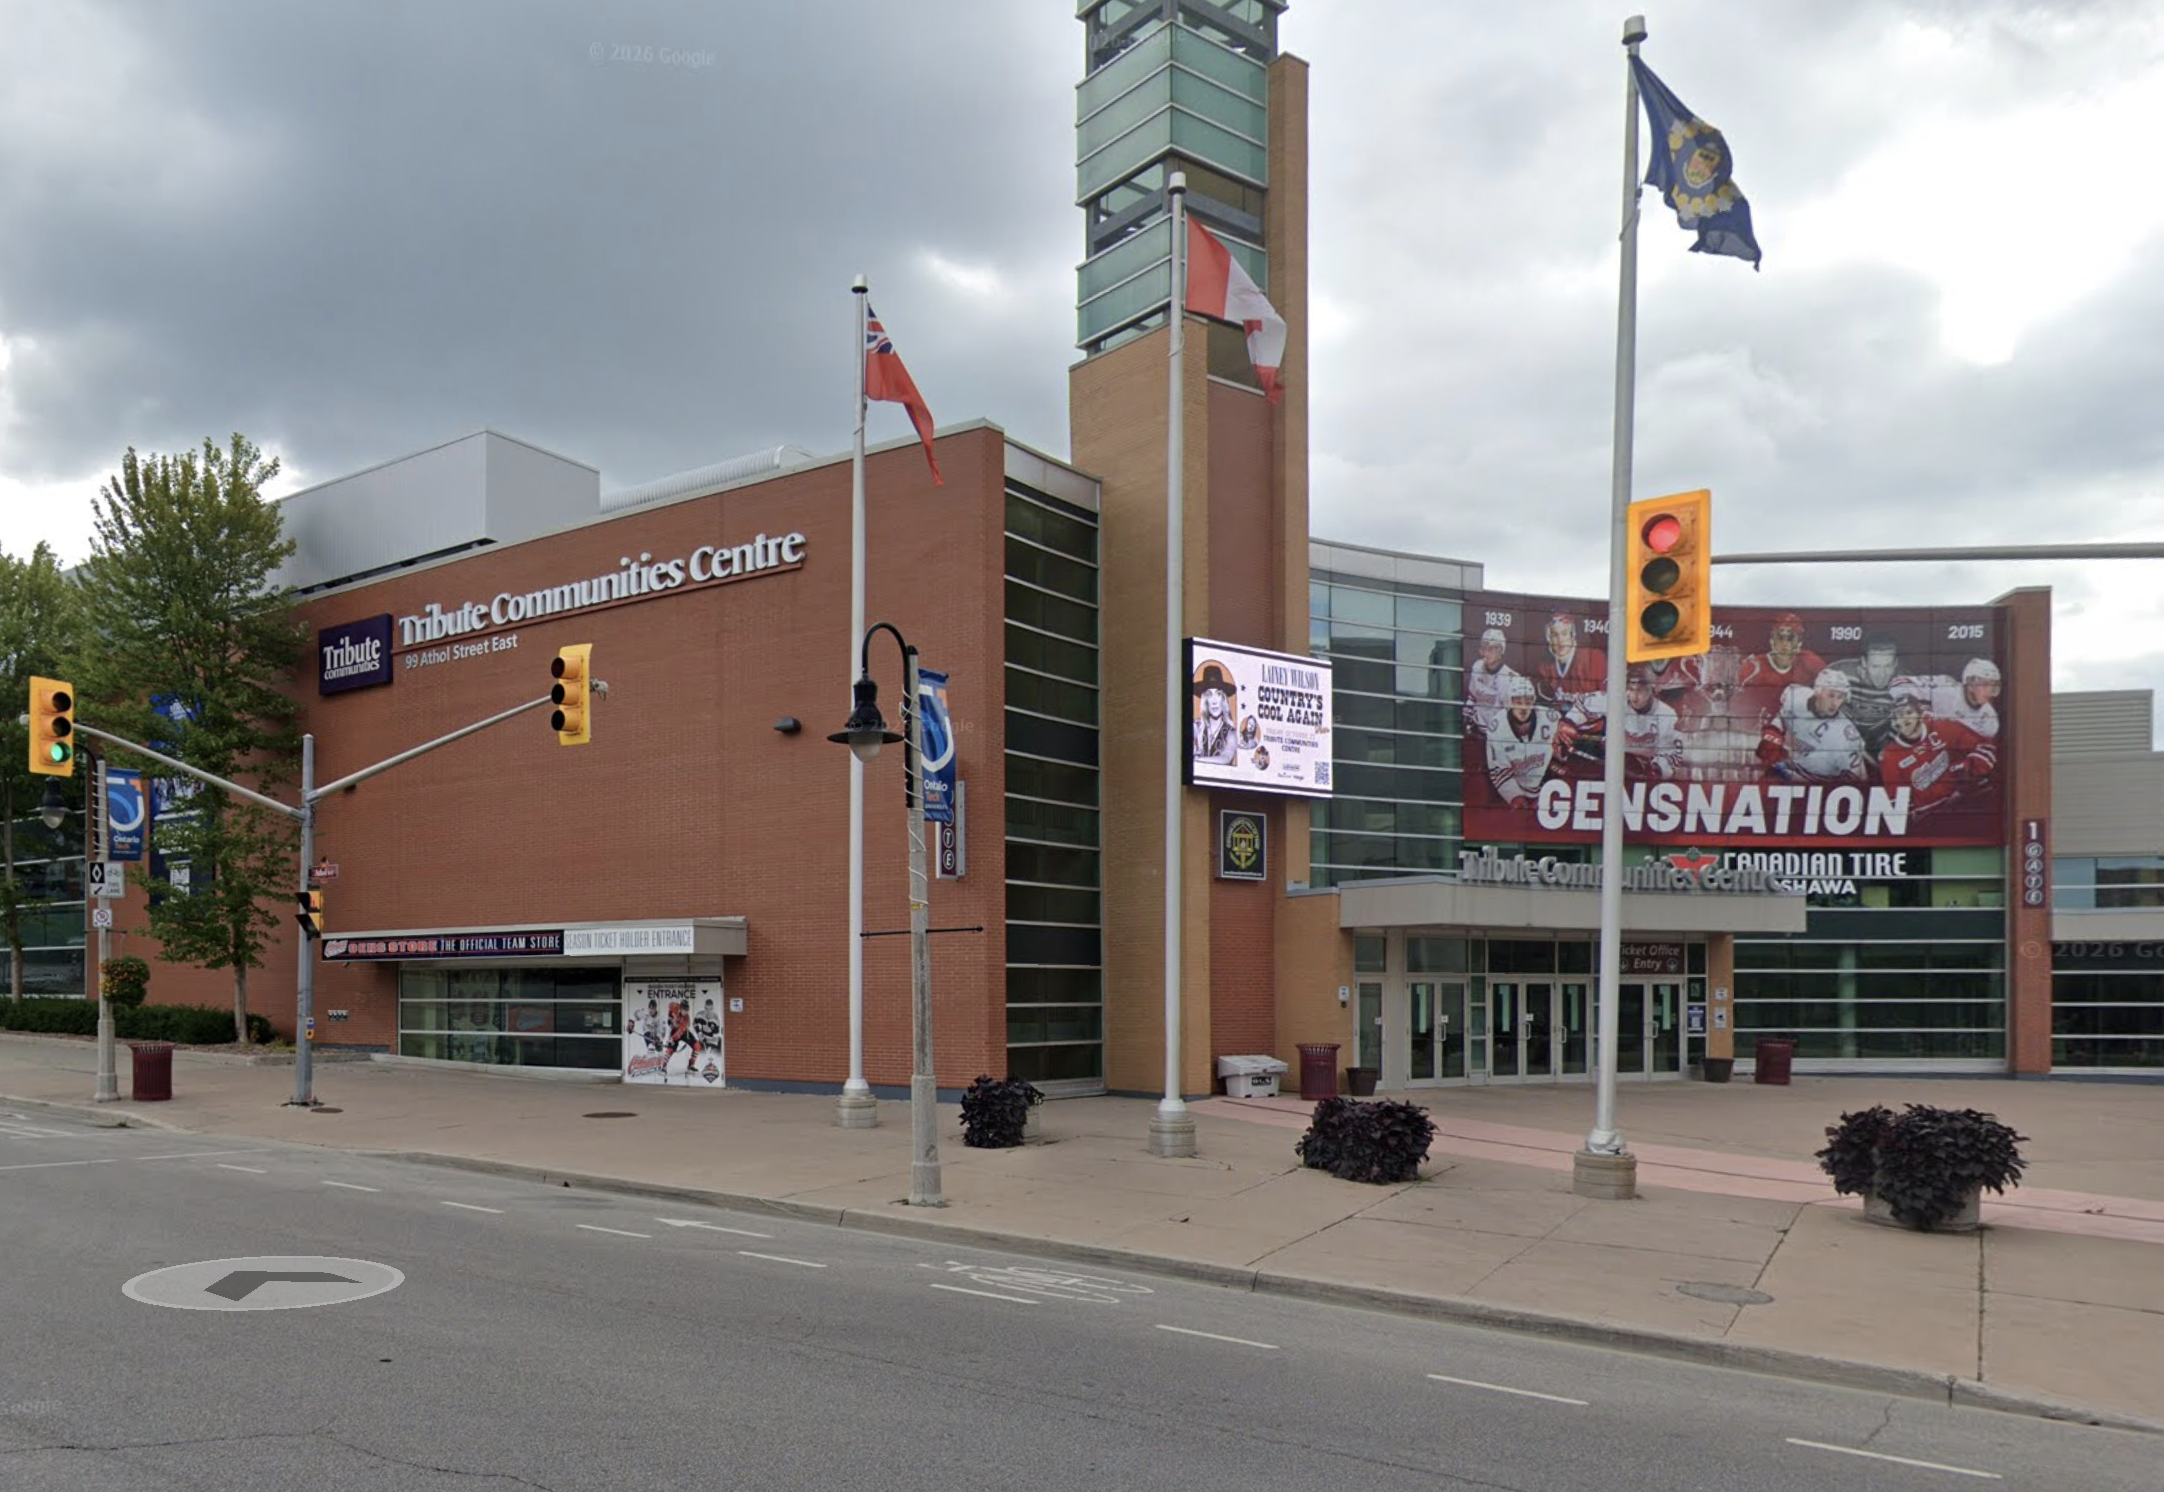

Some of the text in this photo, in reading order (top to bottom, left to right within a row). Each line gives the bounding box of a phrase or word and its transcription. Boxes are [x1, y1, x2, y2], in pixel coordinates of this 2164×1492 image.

[399, 532, 806, 647] Tribute Communities Centre
[1484, 611, 1512, 627] 1939
[1709, 625, 1733, 639] 944
[1830, 627, 1862, 640] 1990
[1948, 625, 1984, 639] 2015
[323, 635, 381, 670] Tribute
[405, 633, 518, 669] 99 Athol Street East
[324, 660, 380, 680] communities
[1290, 668, 1319, 691] WILSON
[1258, 686, 1324, 711] COUNTRY'S
[1258, 704, 1324, 726] COOL AGAIN
[1537, 779, 1910, 836] GENSNATION
[1459, 845, 1540, 883] Tribute
[1850, 853, 1907, 877] TIRE
[441, 938, 456, 951] THE
[459, 937, 499, 951] OFFICIAL
[502, 936, 526, 950] TEAM
[530, 935, 561, 949] STORE
[564, 928, 692, 949] SEASON TICKET HOLDER ENTRANCE
[1649, 944, 1680, 957] Office
[1633, 957, 1662, 972] Entry
[648, 989, 696, 999] ENTRANCE
